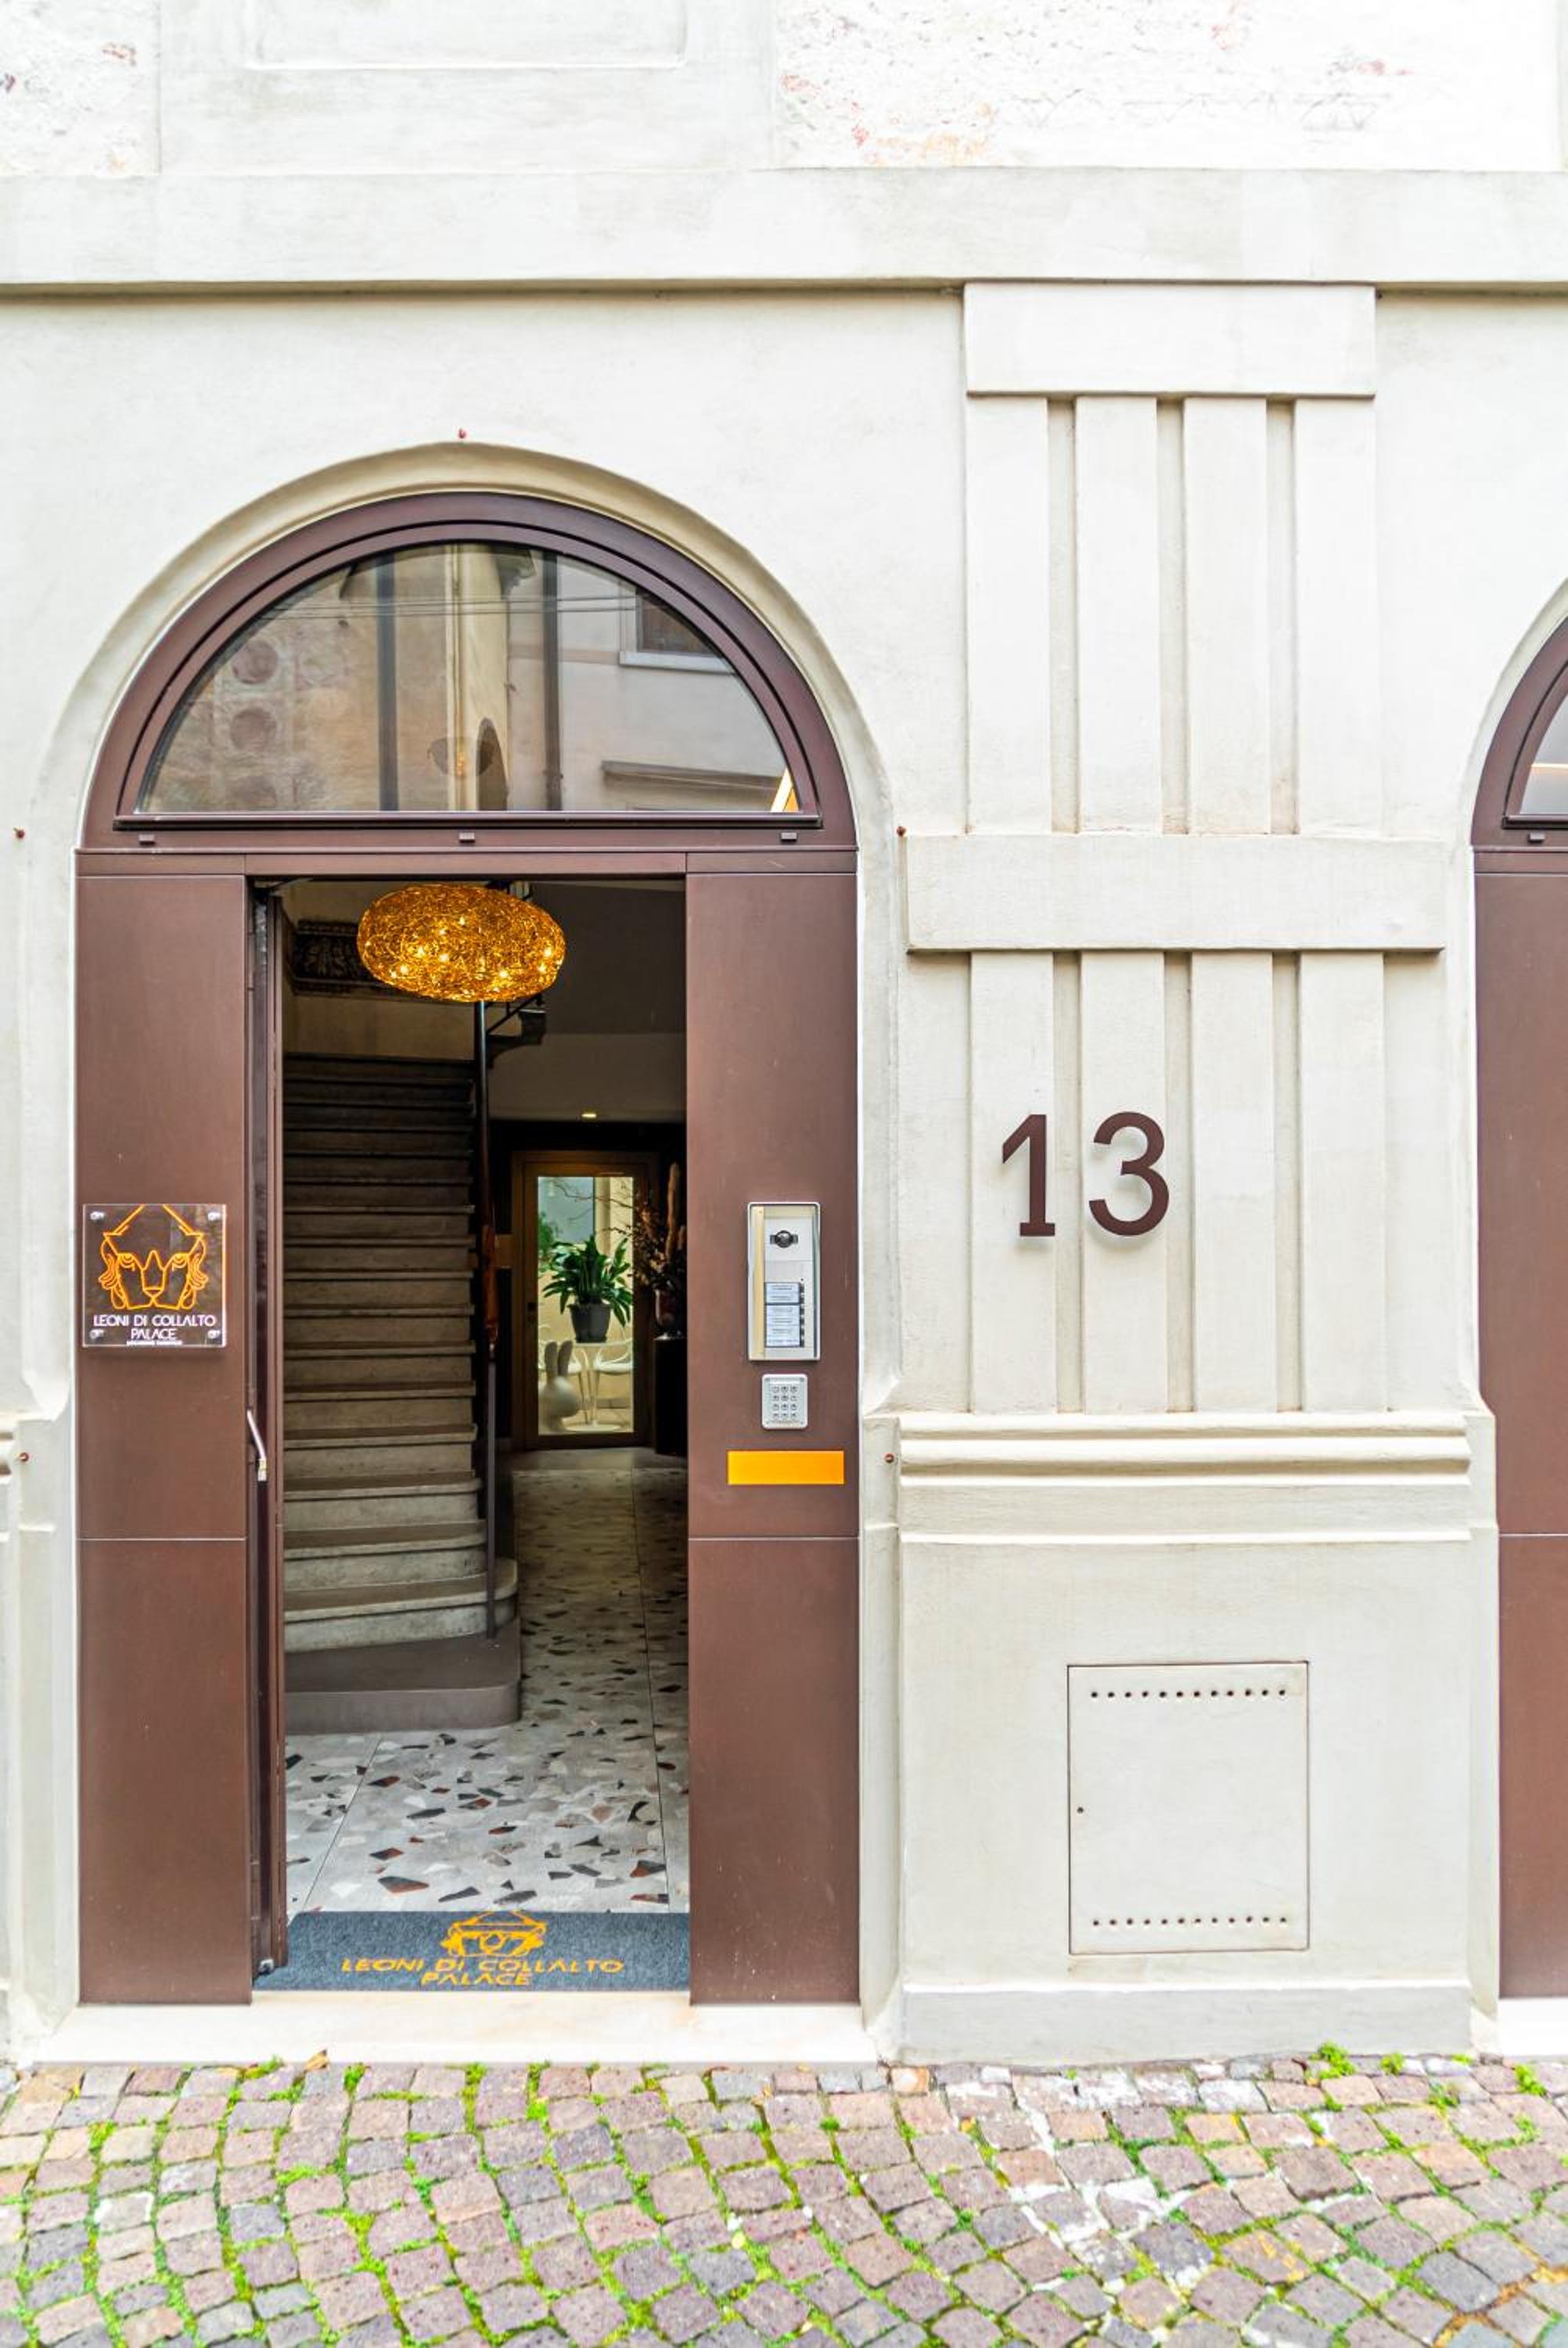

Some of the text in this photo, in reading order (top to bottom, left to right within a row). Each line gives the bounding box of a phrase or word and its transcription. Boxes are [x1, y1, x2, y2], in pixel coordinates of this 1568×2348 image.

[1002, 1111, 1169, 1237] 13
[93, 1314, 216, 1327] LEONI DI COLLALTO
[131, 1328, 178, 1339] PALACE
[342, 1958, 624, 1973] LEONI DI COLLALTO
[420, 1972, 530, 1986] PALACE
